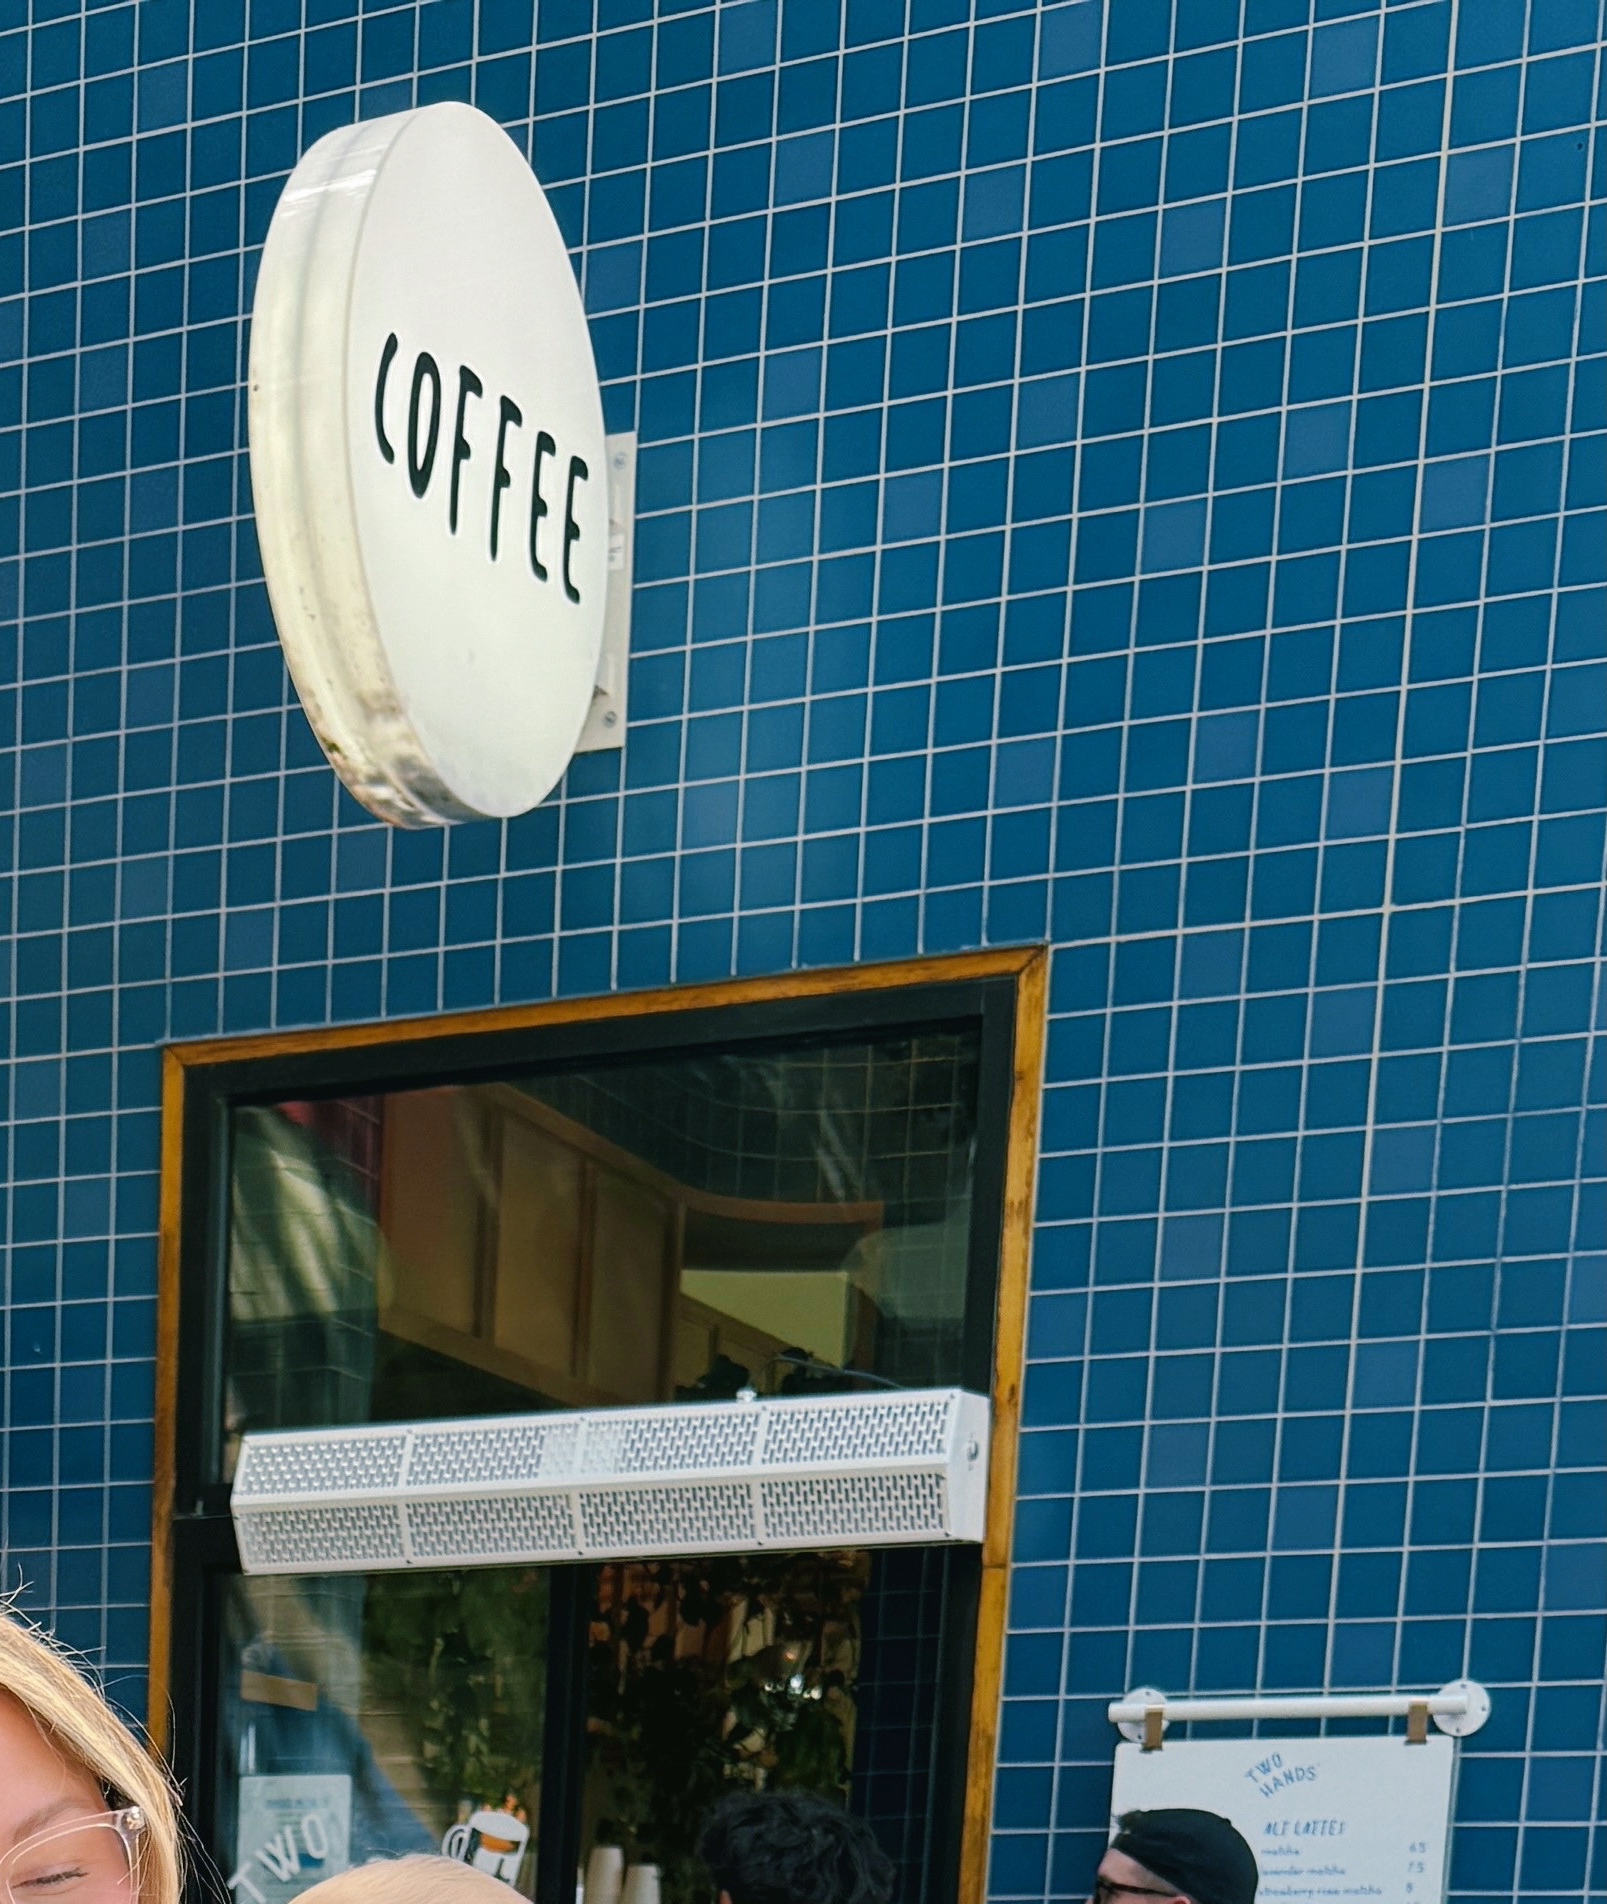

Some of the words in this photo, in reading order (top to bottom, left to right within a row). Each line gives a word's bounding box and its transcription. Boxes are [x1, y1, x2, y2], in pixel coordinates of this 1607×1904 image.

[375, 332, 588, 605] COFFEE
[1244, 1751, 1283, 1783] TWO
[1259, 1766, 1316, 1798] HANDS
[227, 1814, 329, 1904] TWO
